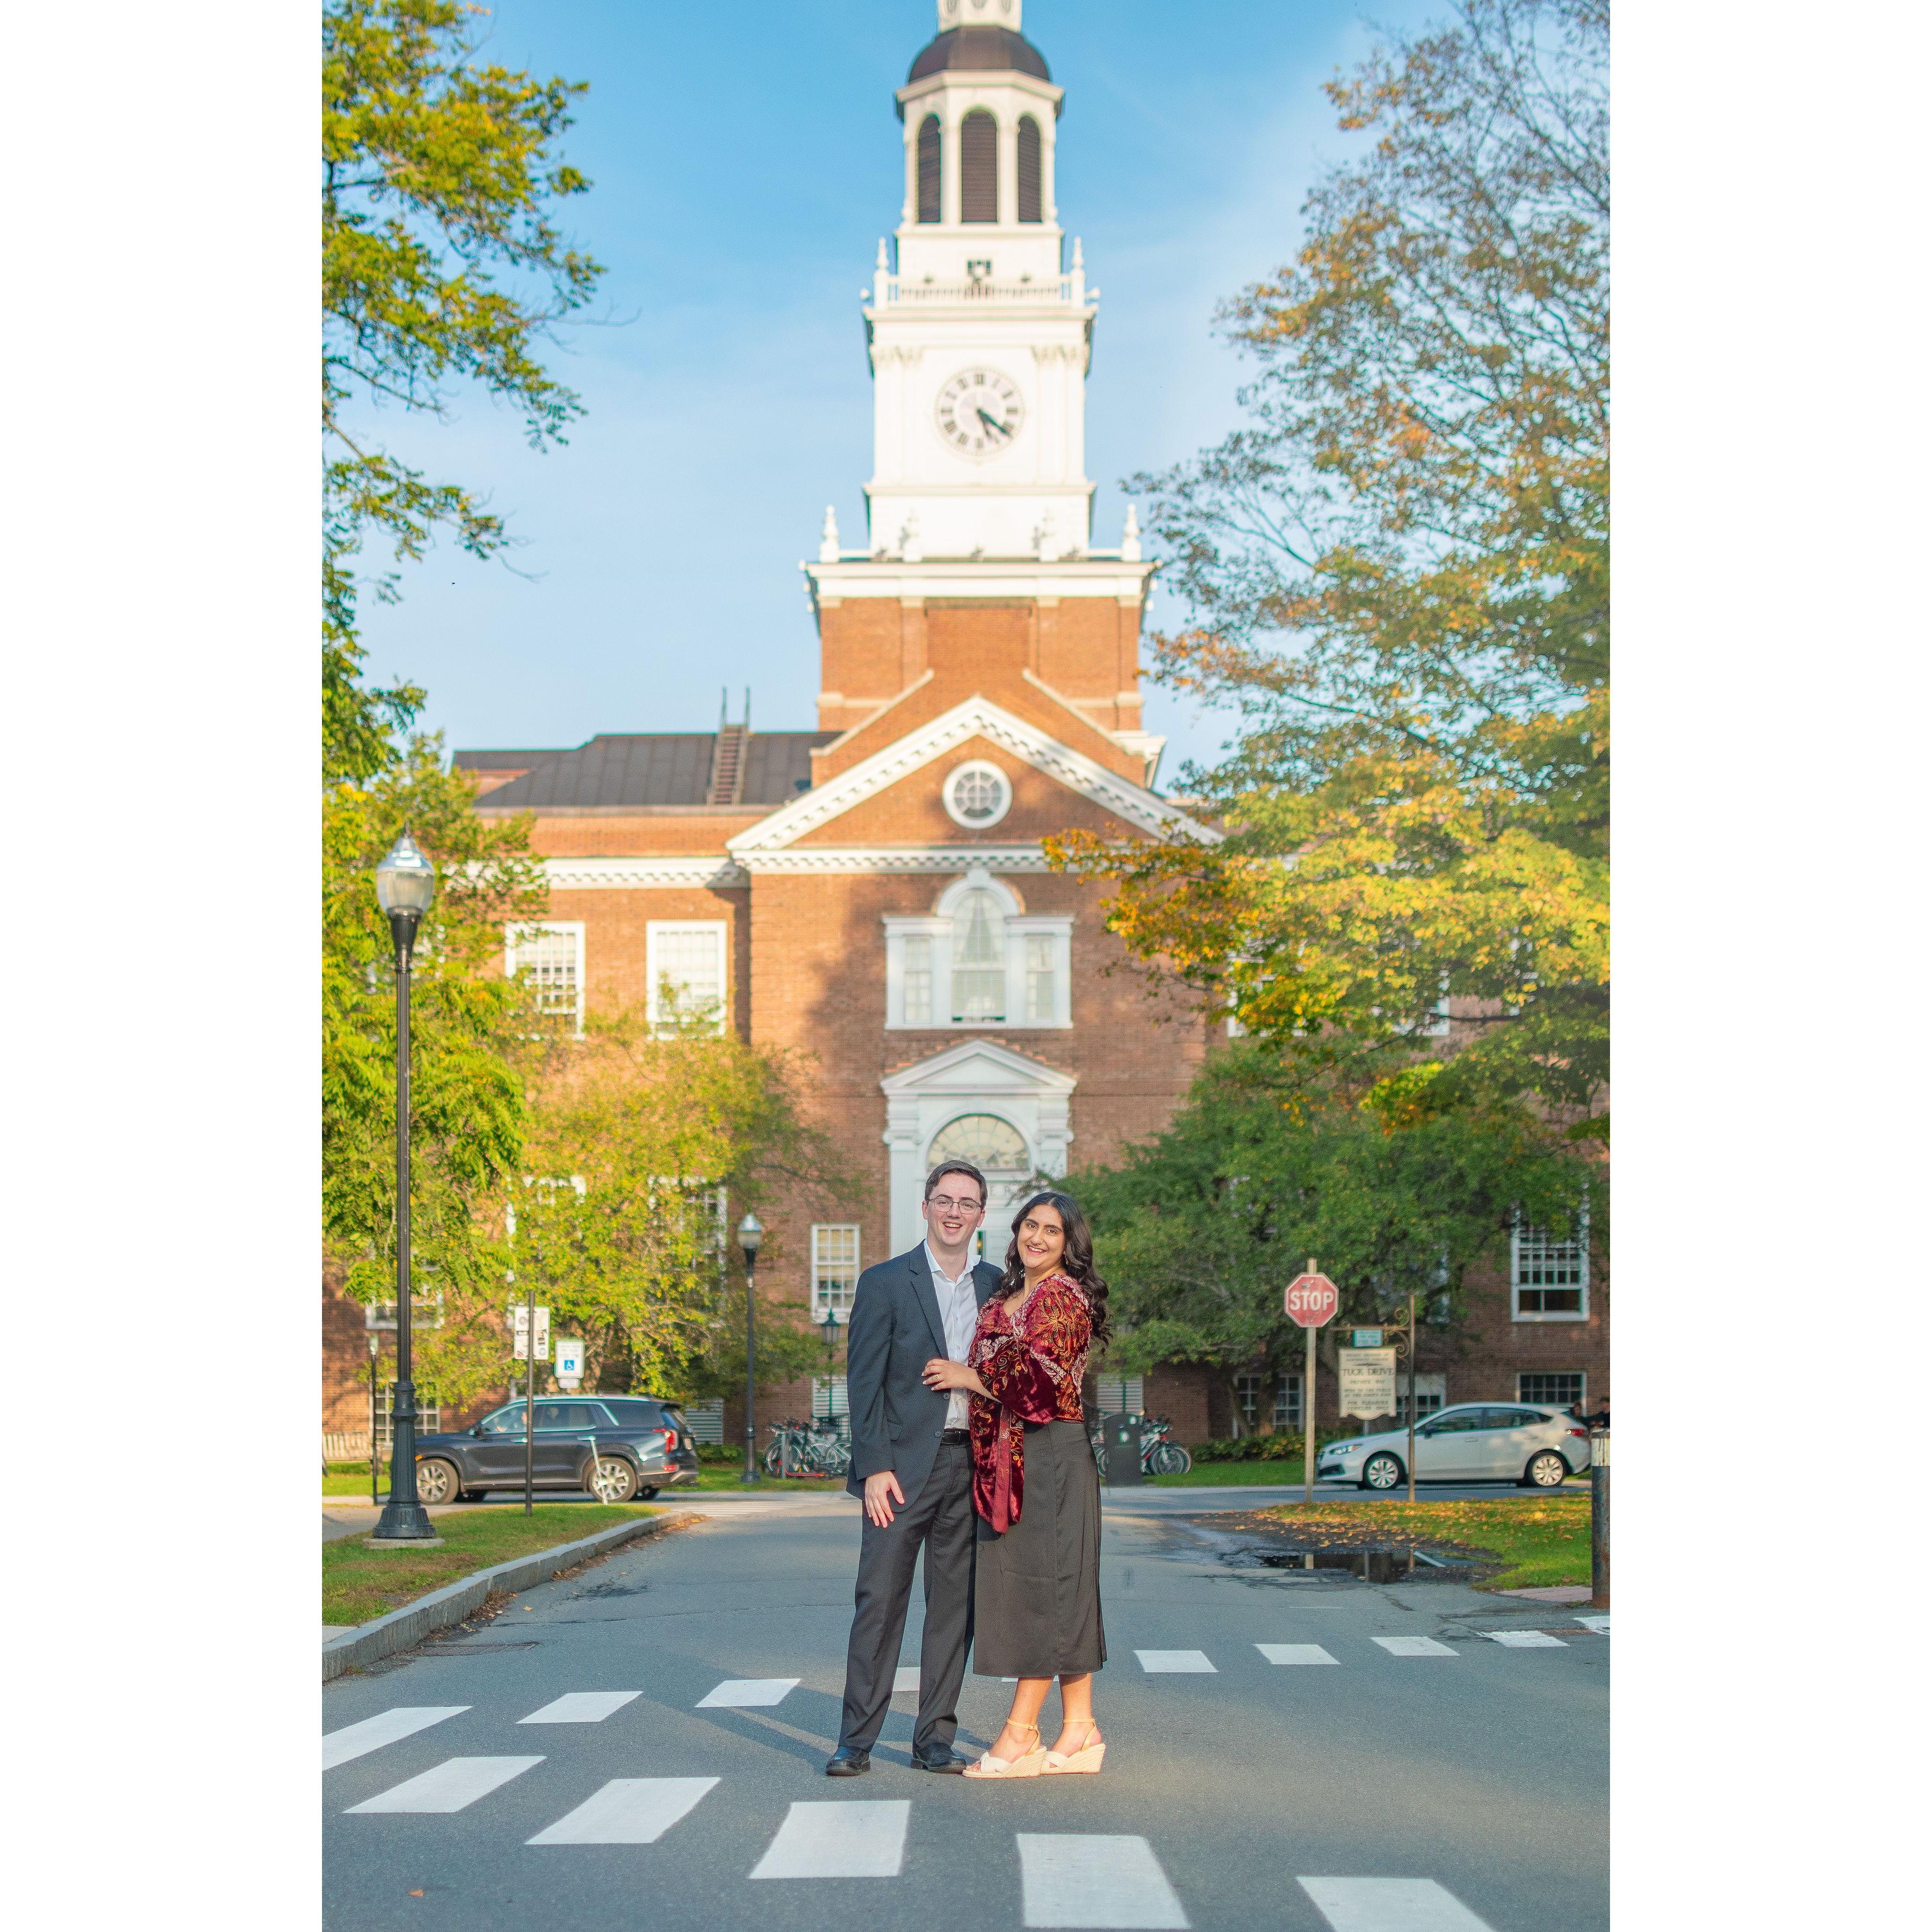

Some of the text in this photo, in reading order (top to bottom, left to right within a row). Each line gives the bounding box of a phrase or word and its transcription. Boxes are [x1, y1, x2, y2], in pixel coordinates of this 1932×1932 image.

[1290, 1291, 1334, 1311] STOP
[1341, 1368, 1394, 1377] TUCK DRIVE
